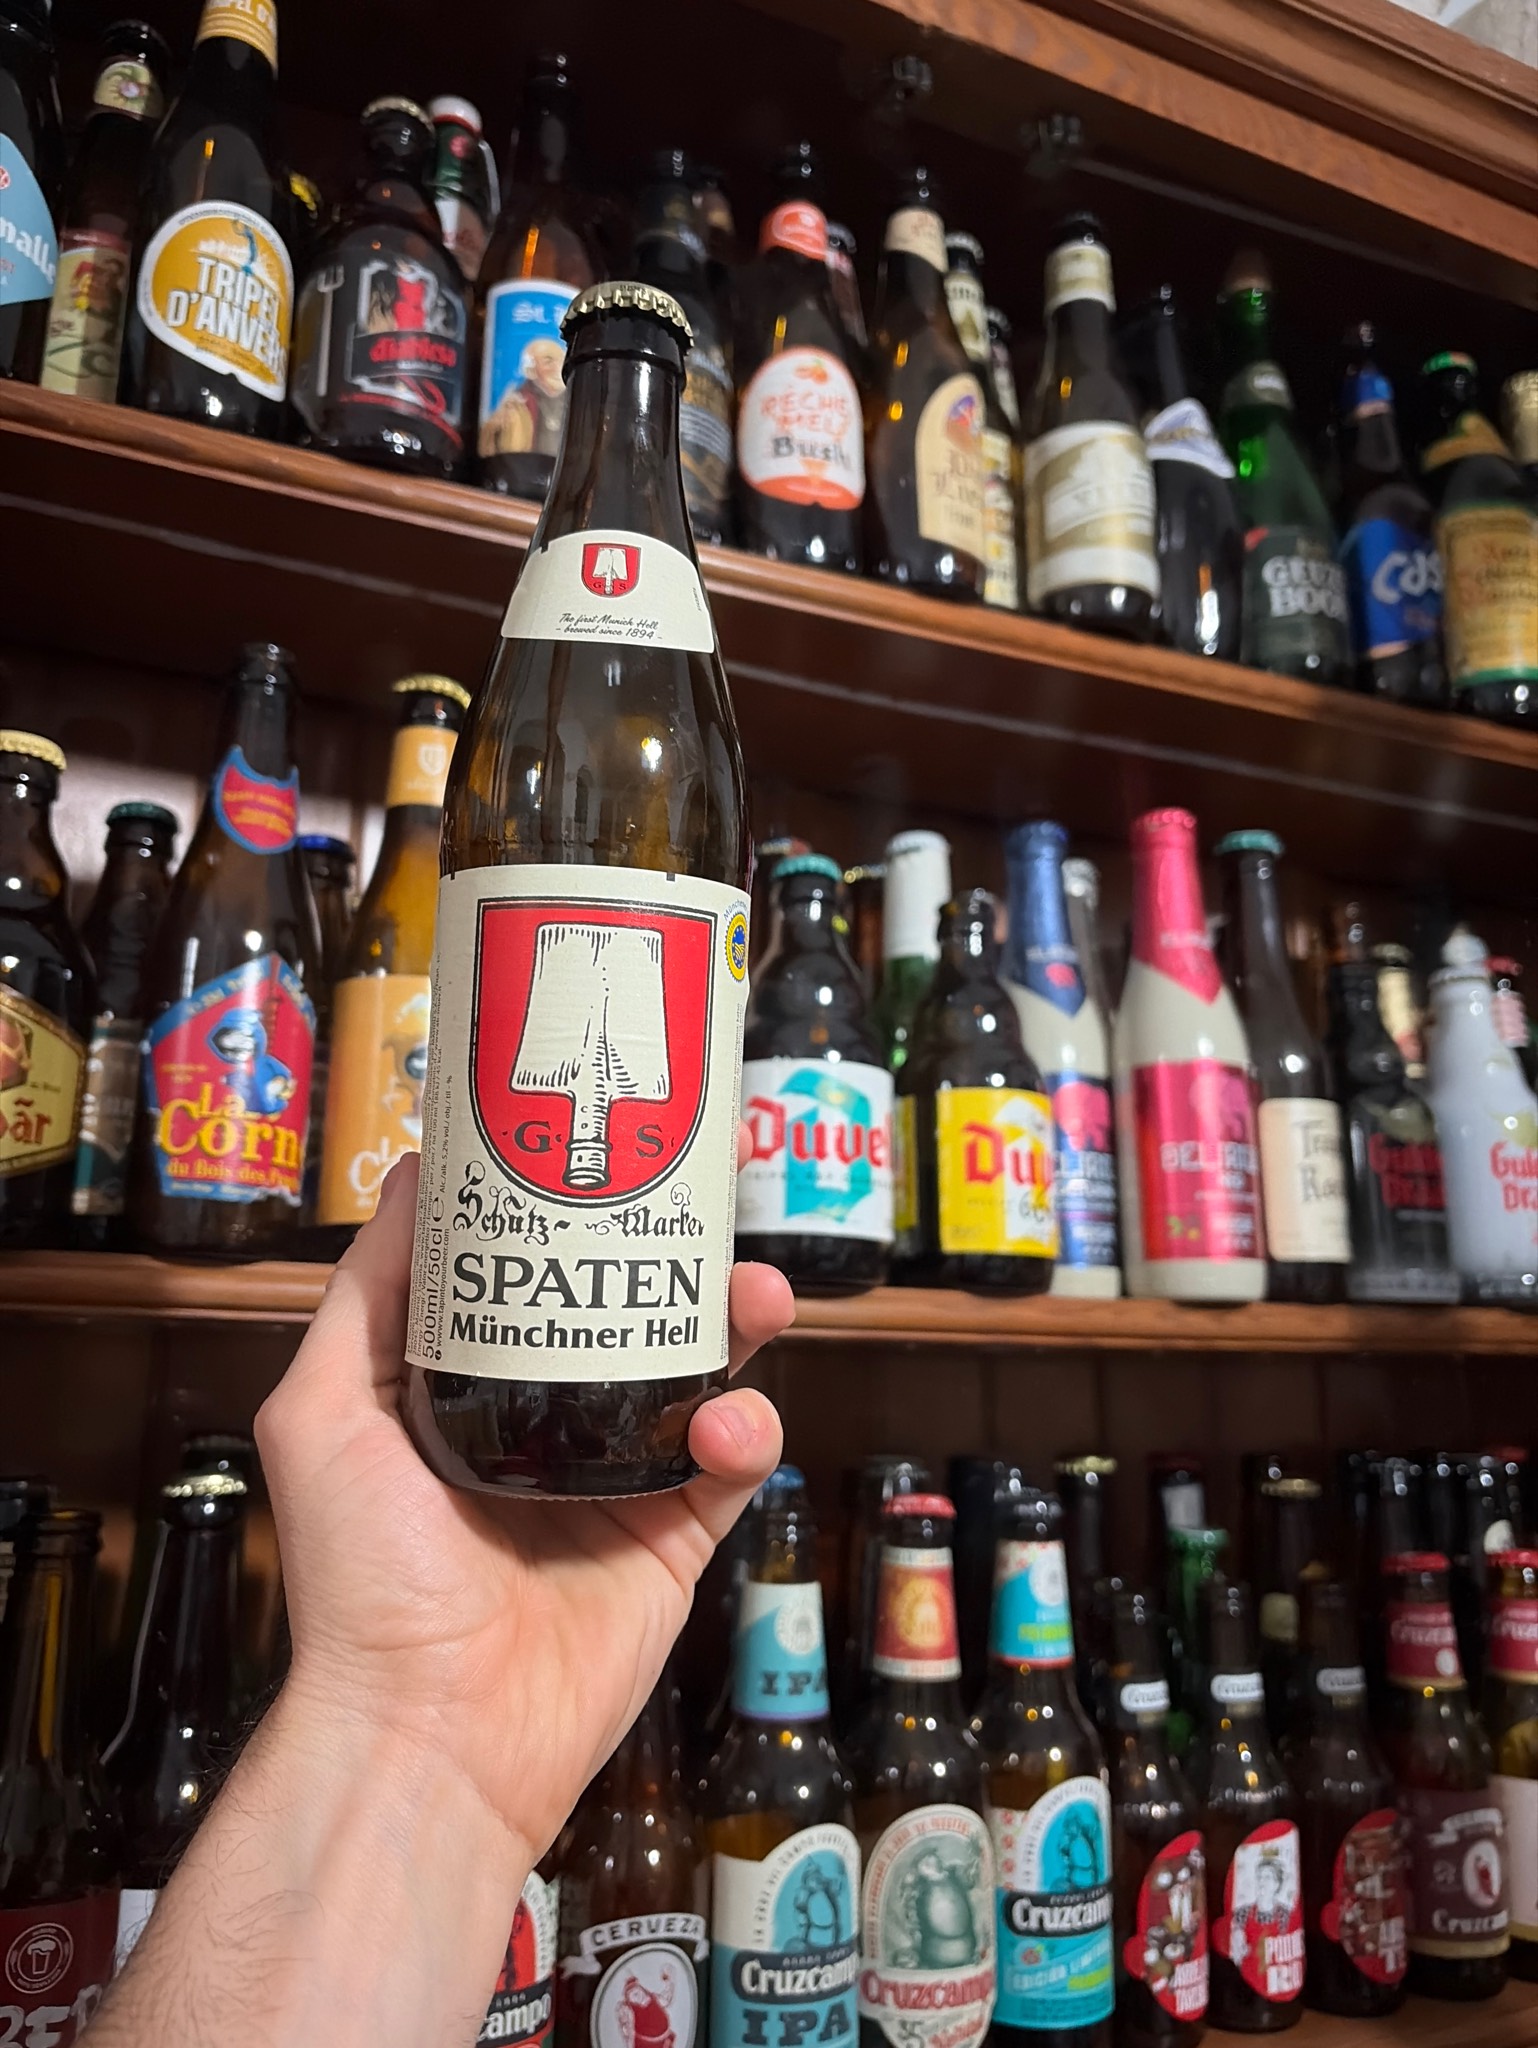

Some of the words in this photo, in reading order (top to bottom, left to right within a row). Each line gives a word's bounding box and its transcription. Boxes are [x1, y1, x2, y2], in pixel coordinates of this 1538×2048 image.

[559, 612, 575, 624] The
[574, 614, 598, 627] first
[597, 614, 634, 627] Munich
[636, 619, 659, 630] Hell
[563, 625, 599, 634] brewed
[599, 626, 623, 636] since
[625, 627, 654, 640] 1894
[441, 1138, 450, 1160] 5,2%
[514, 1120, 551, 1155] G
[635, 1124, 666, 1159] S
[452, 1251, 704, 1309] SPATEN
[449, 1311, 634, 1349] Münchner
[645, 1315, 698, 1347] Hell
[742, 2001, 853, 2047] IPA
